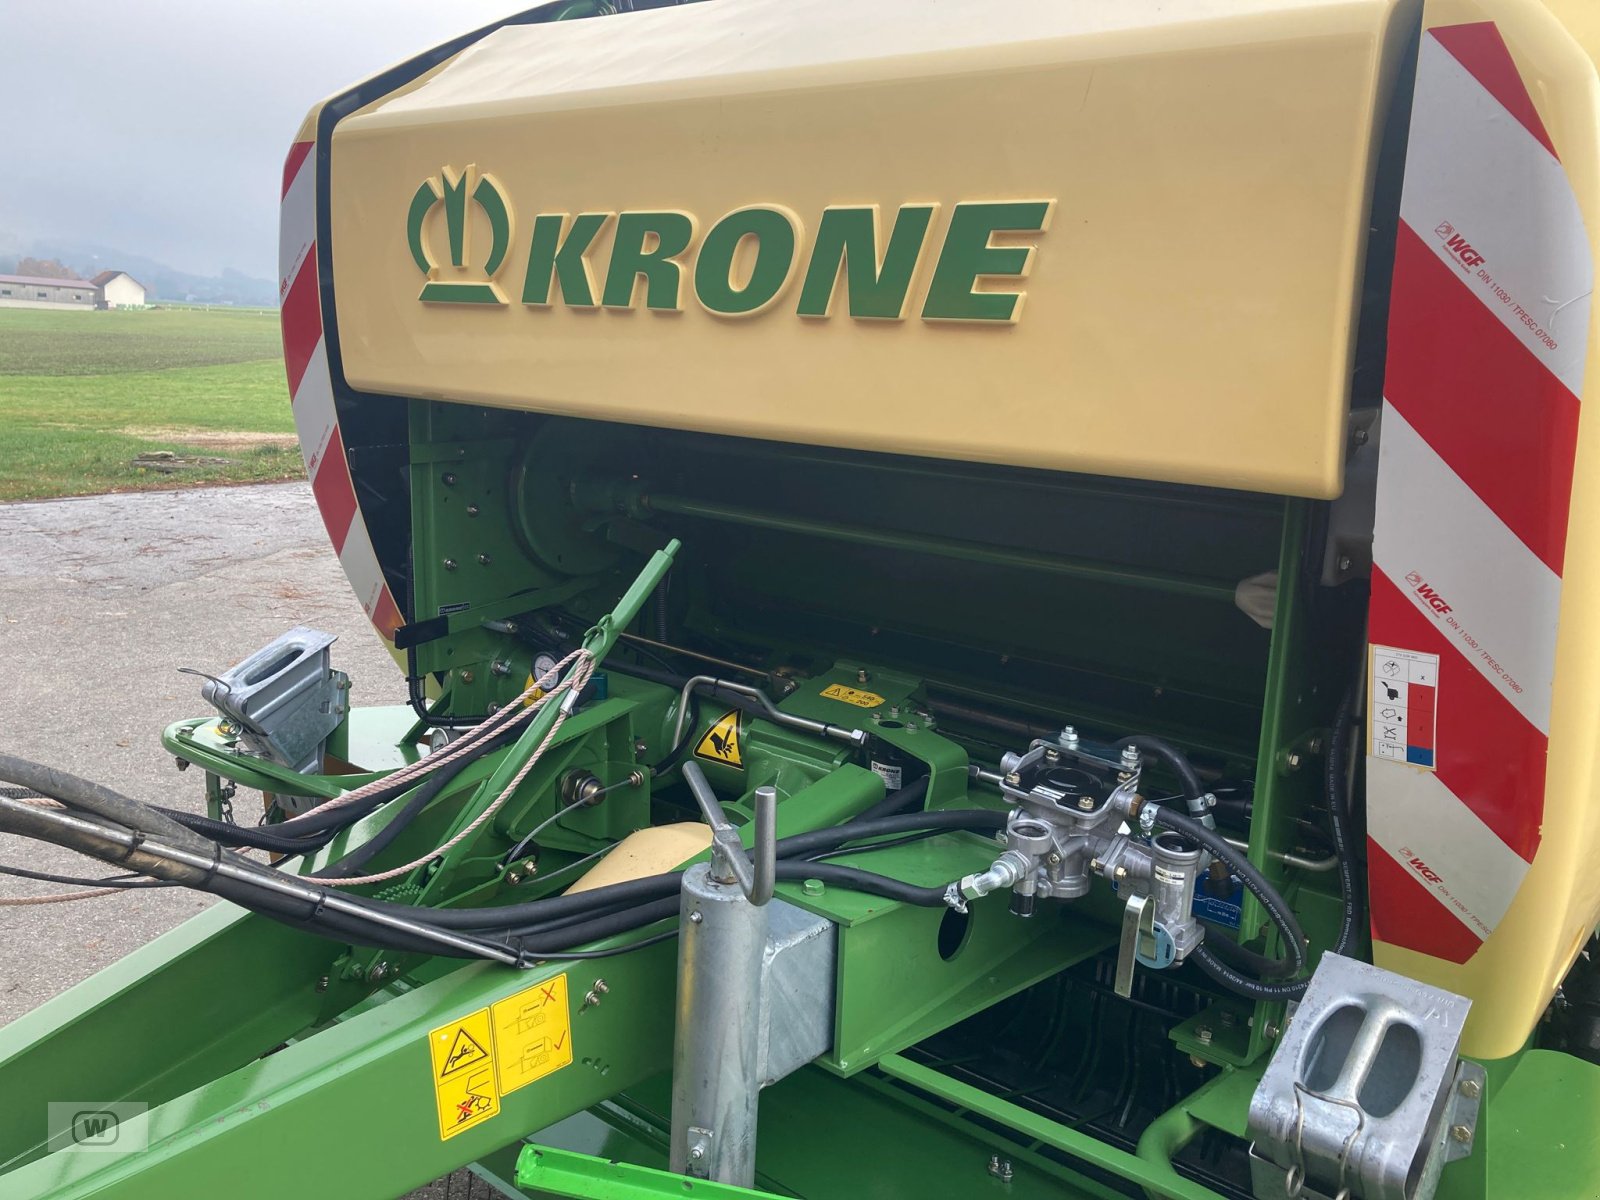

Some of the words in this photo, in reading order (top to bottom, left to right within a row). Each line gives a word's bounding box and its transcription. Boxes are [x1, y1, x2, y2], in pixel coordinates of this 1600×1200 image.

[522, 198, 1058, 325] KRONE
[1447, 233, 1486, 267] WGF
[1477, 269, 1492, 284] DIN
[1490, 283, 1512, 304] 11030
[1512, 304, 1538, 331] TPESC
[1535, 328, 1558, 351] 07080
[1417, 583, 1453, 615] WGF
[1446, 616, 1461, 630] DIN
[1459, 629, 1479, 649] 11030
[1480, 651, 1504, 674] TPESC
[1502, 673, 1523, 694] 07080
[1410, 858, 1444, 884] WGF
[1208, 957, 1222, 972] MADE
